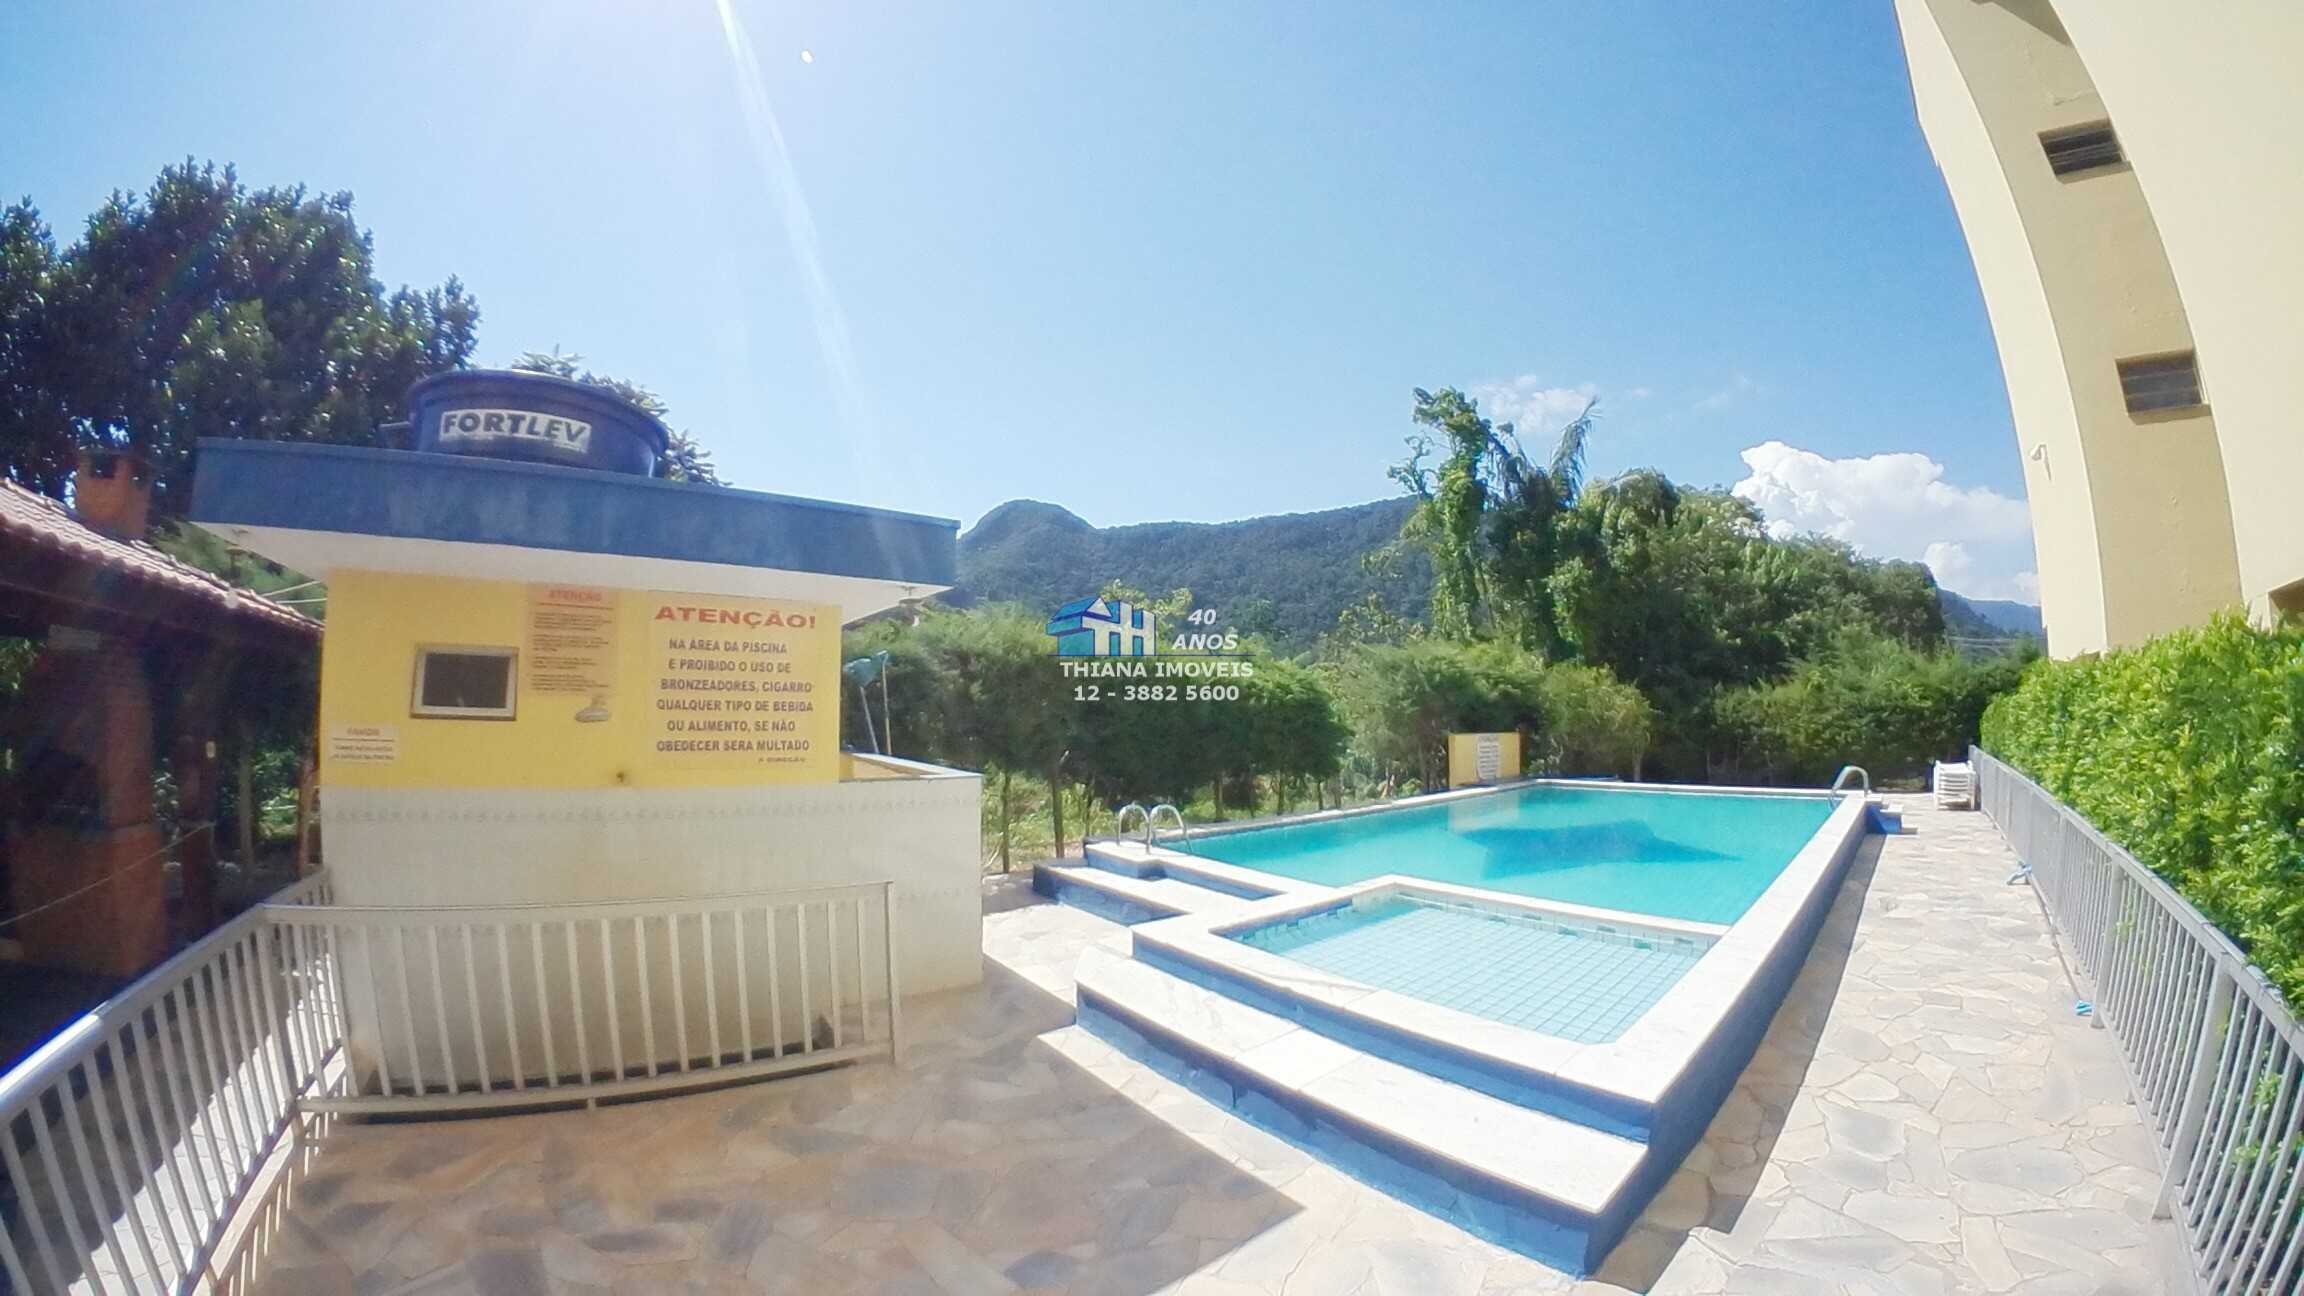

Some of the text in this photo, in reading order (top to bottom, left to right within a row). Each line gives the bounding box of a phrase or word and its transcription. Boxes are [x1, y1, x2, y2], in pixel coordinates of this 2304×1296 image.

[443, 412, 587, 443] FORTLEV
[655, 606, 816, 629] ATENÇÃO!
[669, 638, 687, 650] NA
[724, 640, 739, 652] DA
[742, 641, 787, 654] PISCINA
[679, 659, 736, 672] PROIBIDO
[738, 661, 748, 672] O
[750, 662, 774, 673] USO
[777, 662, 791, 674] DE
[660, 678, 813, 693] BRONZEADORES, CIGARRO
[656, 699, 814, 712] QUALQUER TIPO DE BEBIDA
[667, 720, 684, 732] OU
[688, 720, 751, 733] ALIMENTO,
[754, 720, 769, 732] SE
[656, 740, 720, 752] OBEDECER
[756, 739, 810, 751] MULTADO
